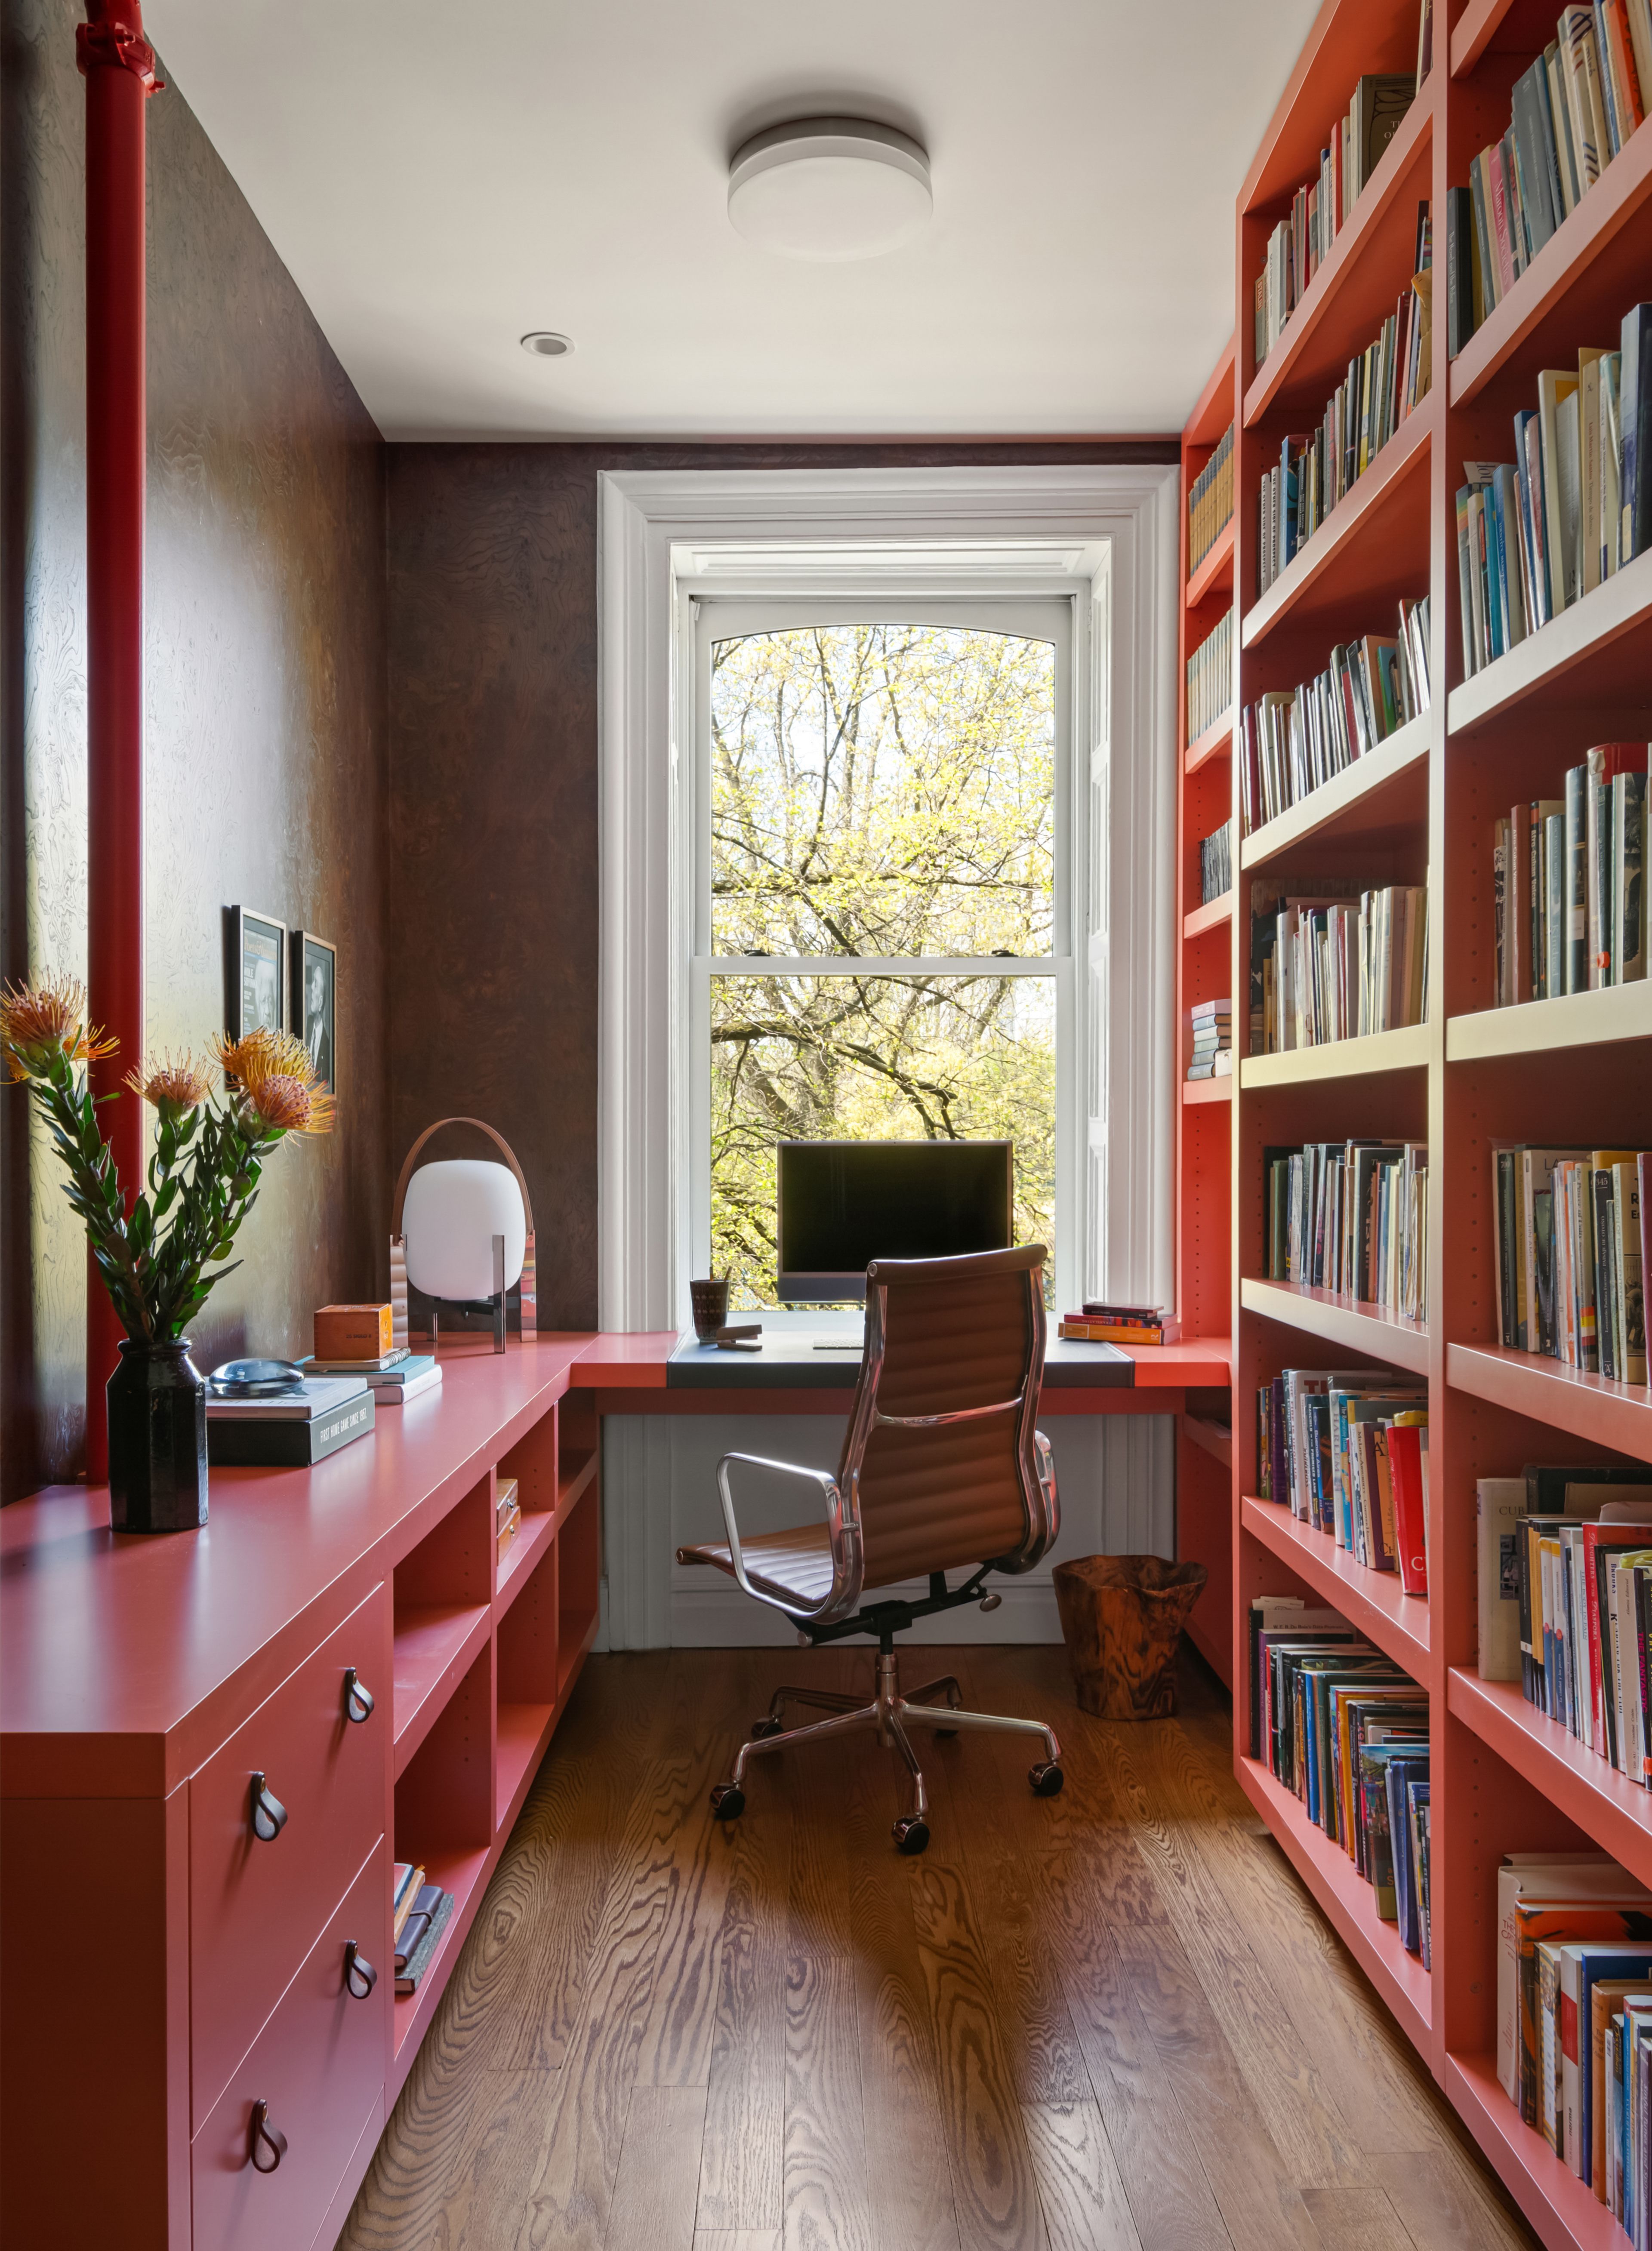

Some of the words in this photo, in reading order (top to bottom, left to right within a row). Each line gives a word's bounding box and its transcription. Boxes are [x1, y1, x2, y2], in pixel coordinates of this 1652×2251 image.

[1586, 46, 1595, 77] miró
[1495, 178, 1505, 228] Maroon
[1499, 228, 1510, 286] Societies
[1597, 1177, 1608, 1186] 345
[1616, 1225, 1621, 1236] OF
[1602, 1238, 1606, 1246] DE
[320, 1427, 330, 1444] FIRST
[330, 1421, 340, 1438] HOME
[340, 1416, 349, 1433] GAME
[350, 1411, 359, 1427] SINCE
[1294, 1468, 1297, 1480] US
[1583, 1612, 1587, 1621] IN
[1640, 1655, 1648, 1714] FANTASTIC
